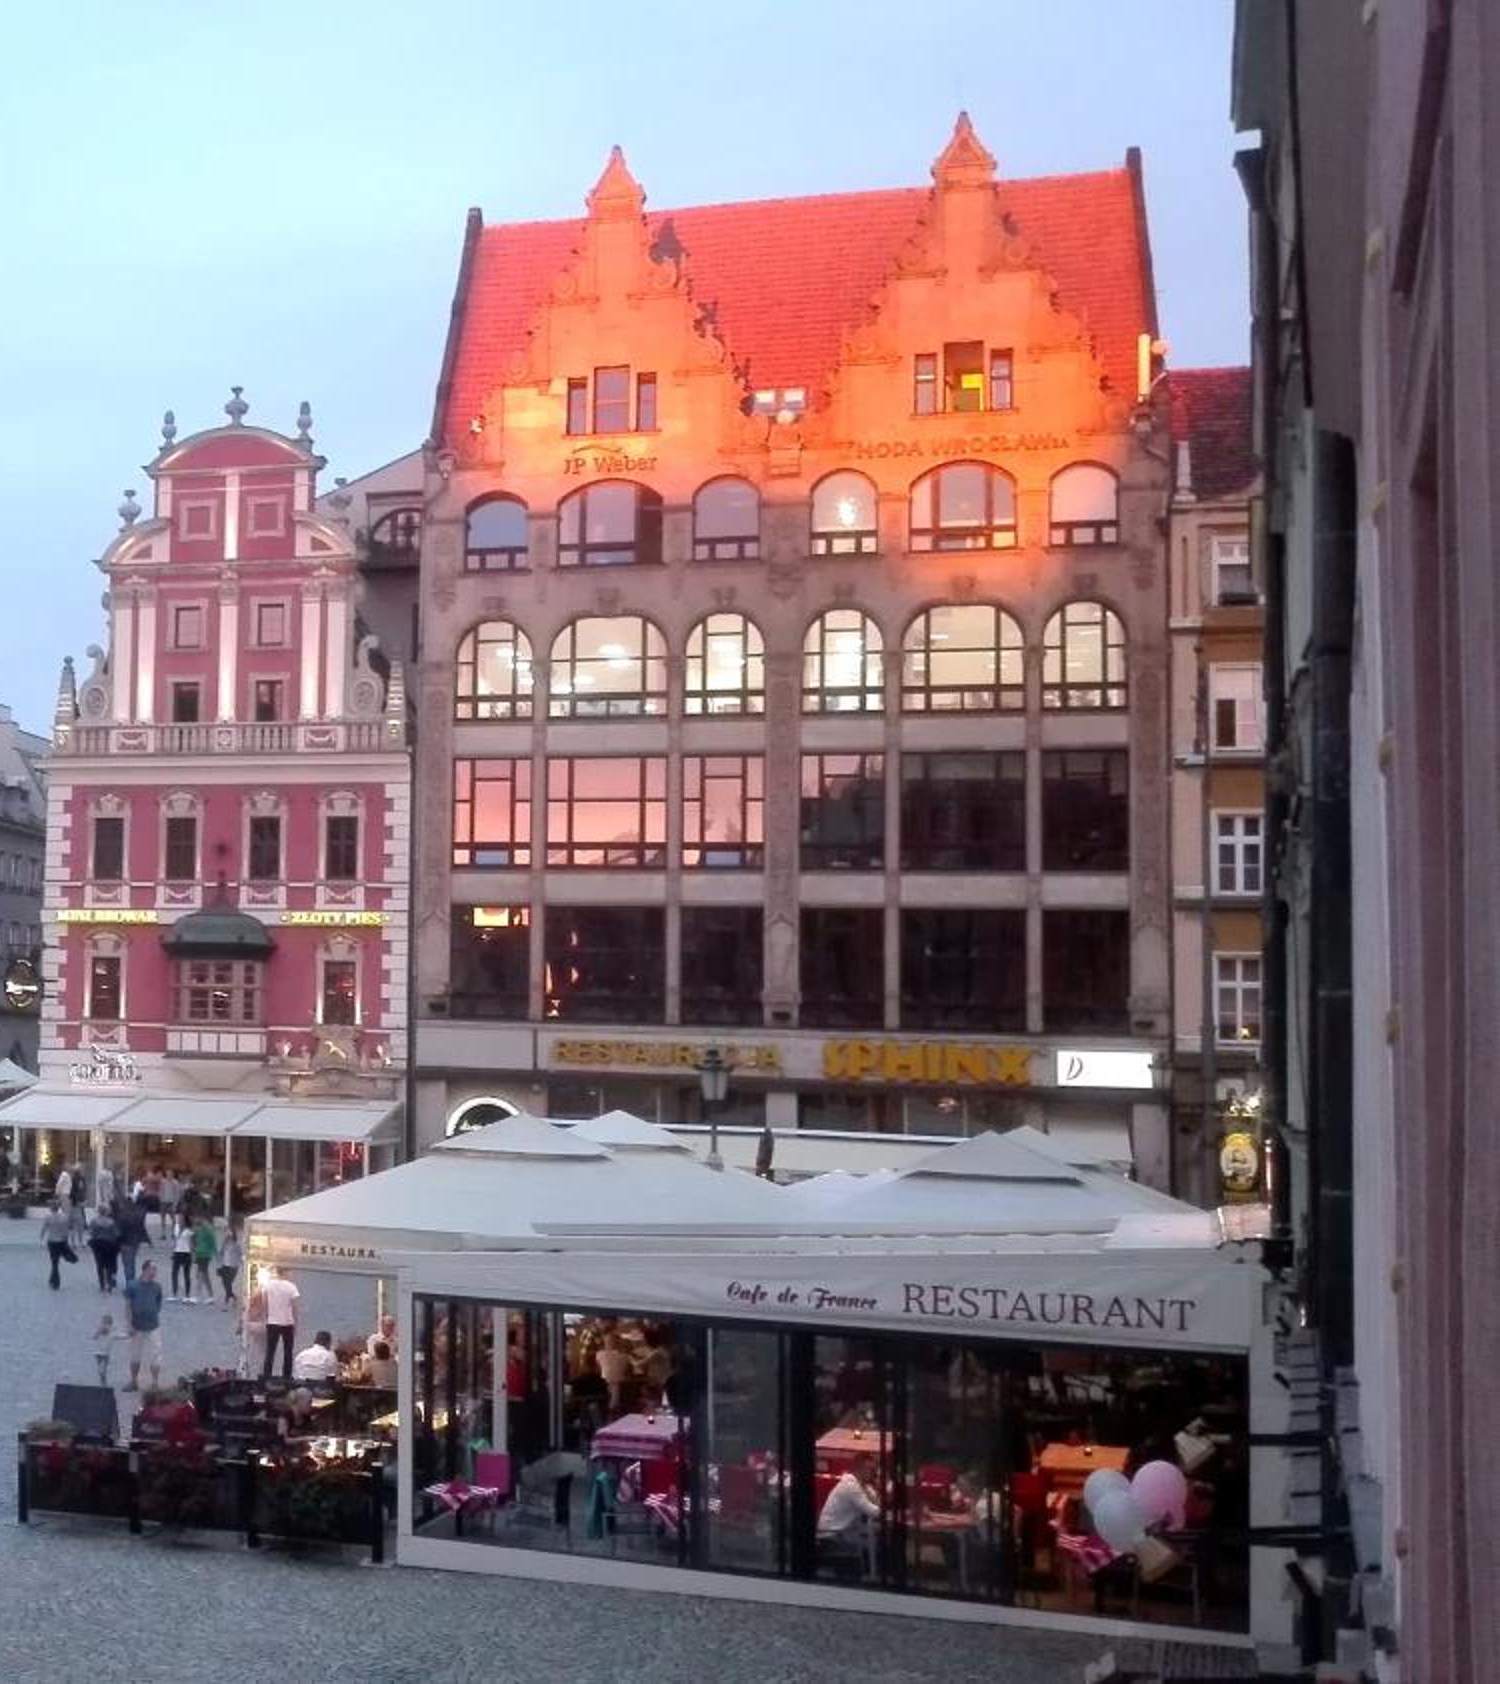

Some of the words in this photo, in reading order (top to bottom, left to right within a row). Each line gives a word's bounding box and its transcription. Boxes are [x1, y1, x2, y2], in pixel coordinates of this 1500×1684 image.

[593, 455, 658, 473] Weber
[822, 1038, 1031, 1084] SPHINX
[726, 1281, 768, 1304] Cafe
[777, 1286, 799, 1304] de
[807, 1287, 879, 1310] France
[902, 1282, 1197, 1332] RESTAURANT
